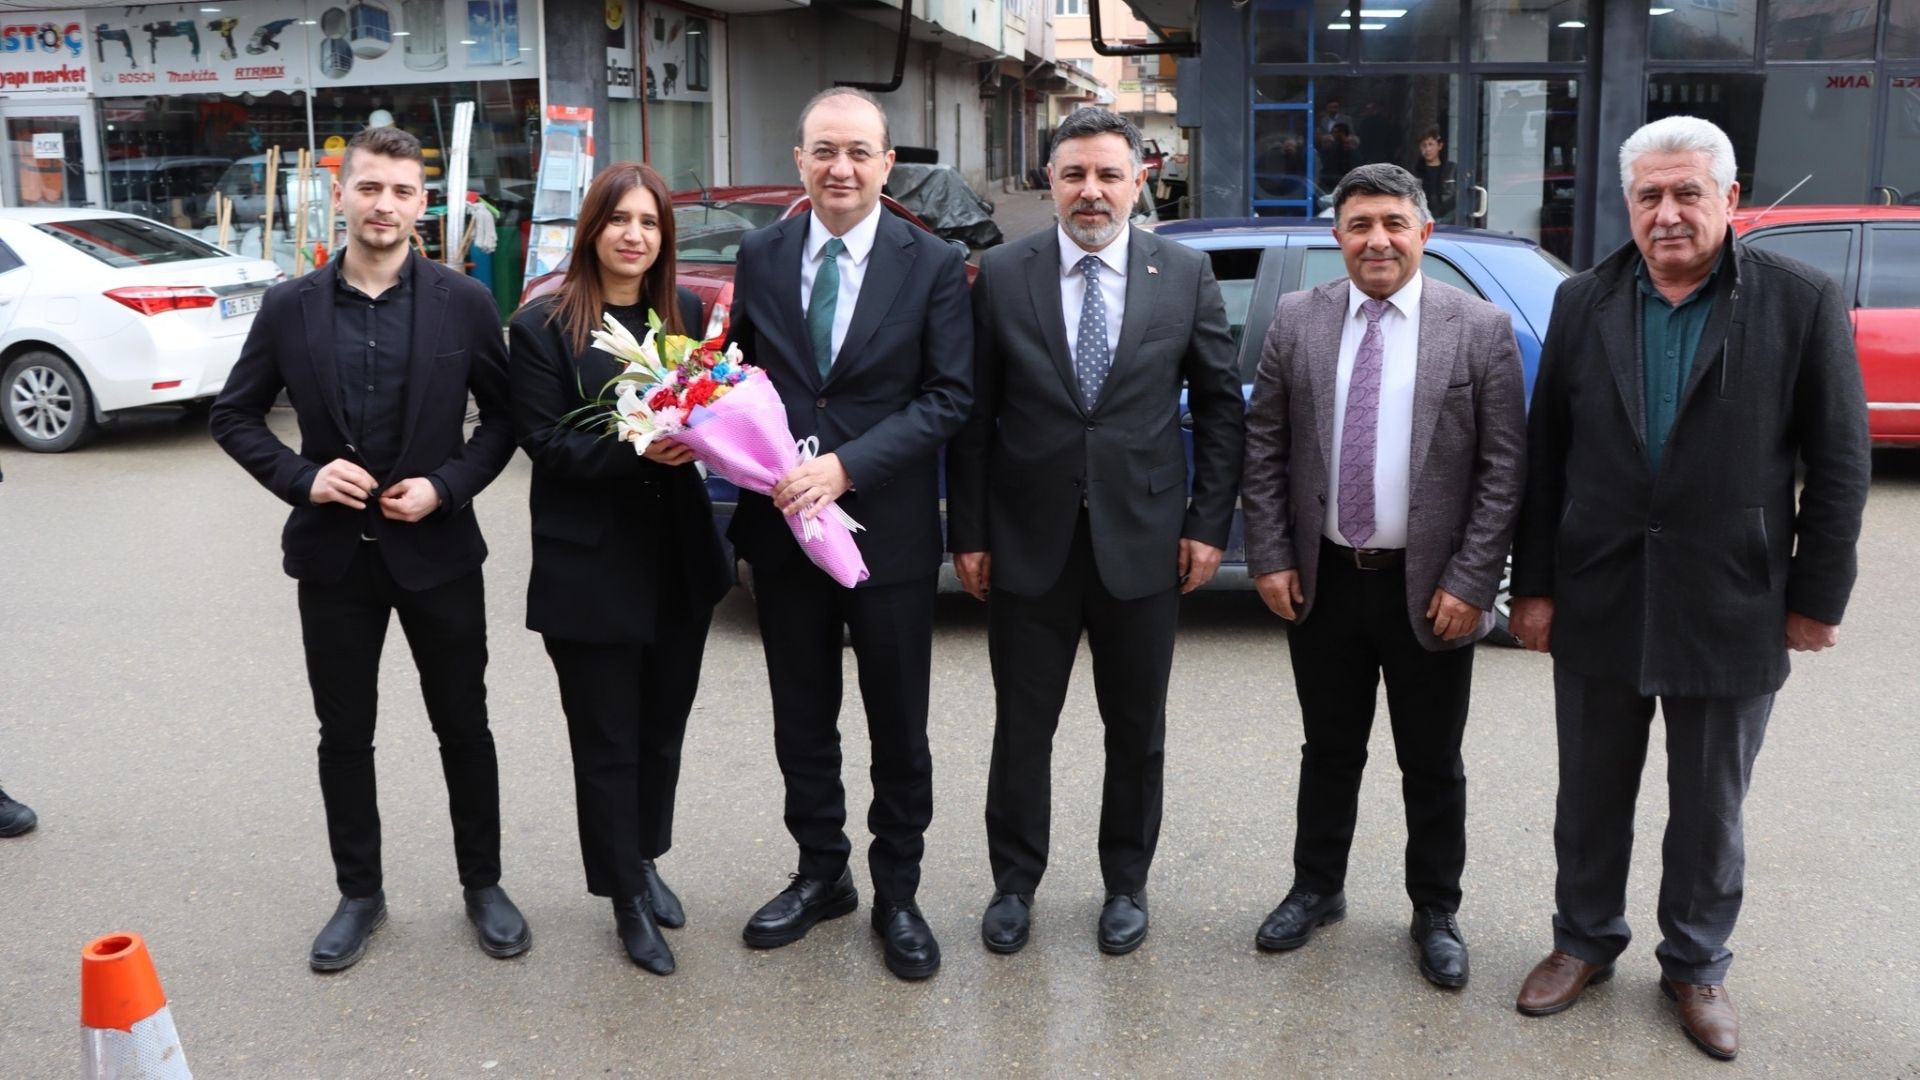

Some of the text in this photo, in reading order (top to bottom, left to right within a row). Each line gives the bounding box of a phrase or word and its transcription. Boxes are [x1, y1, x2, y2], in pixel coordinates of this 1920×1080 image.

[0, 22, 82, 58] STOÇ
[32, 64, 86, 83] market
[118, 72, 156, 84] BOSCH
[234, 66, 285, 80] RTRMAX
